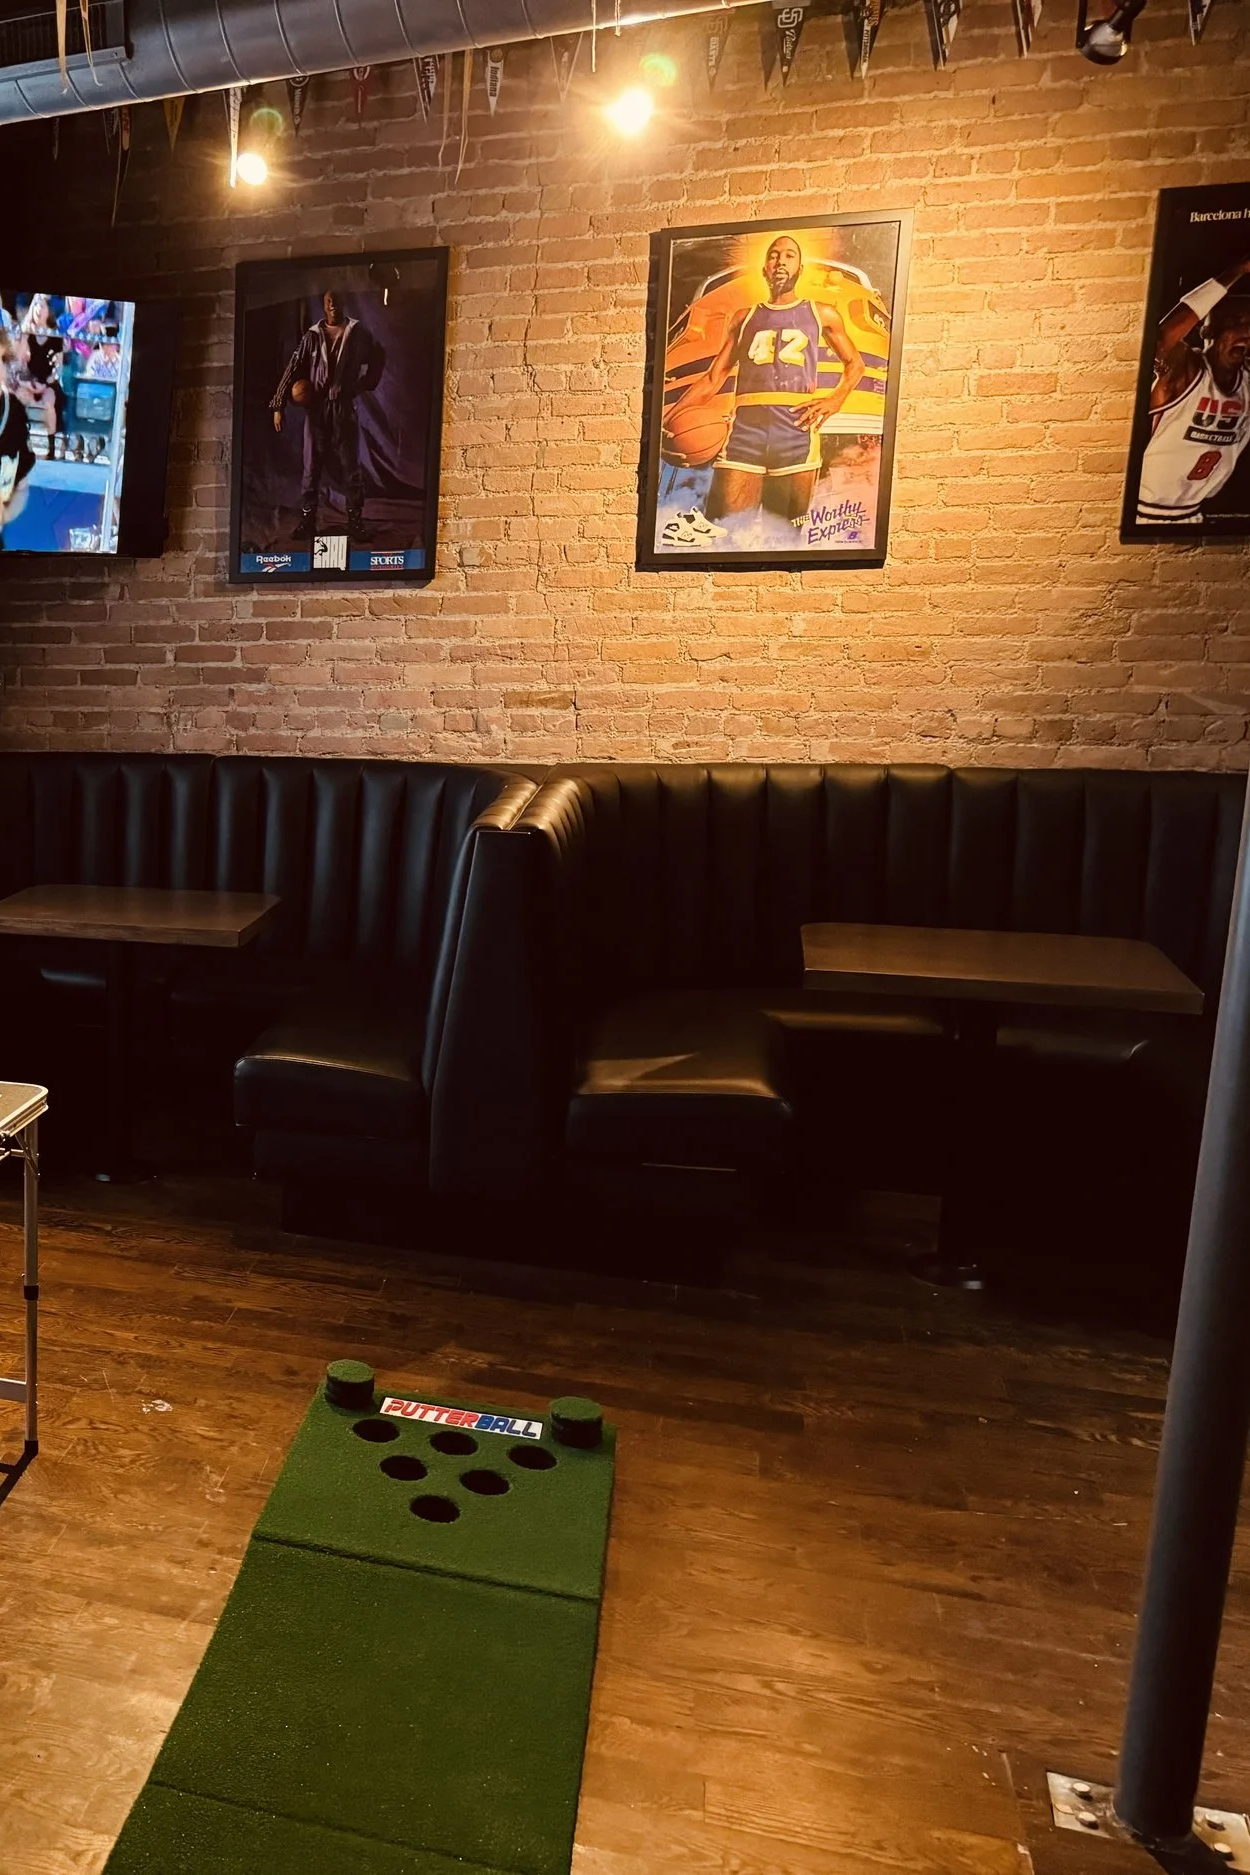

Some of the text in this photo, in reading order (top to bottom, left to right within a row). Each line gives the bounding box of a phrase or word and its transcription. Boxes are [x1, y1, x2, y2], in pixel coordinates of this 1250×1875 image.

[489, 66, 500, 97] Indiana
[1190, 209, 1242, 223] Barcelona
[748, 328, 810, 366] 42
[1187, 450, 1222, 480] 8
[791, 500, 866, 528] THE Worthy
[808, 514, 870, 545] Express
[256, 554, 292, 563] Reebok
[370, 555, 405, 566] SPORTS
[384, 1399, 537, 1437] PUTTERBALL
